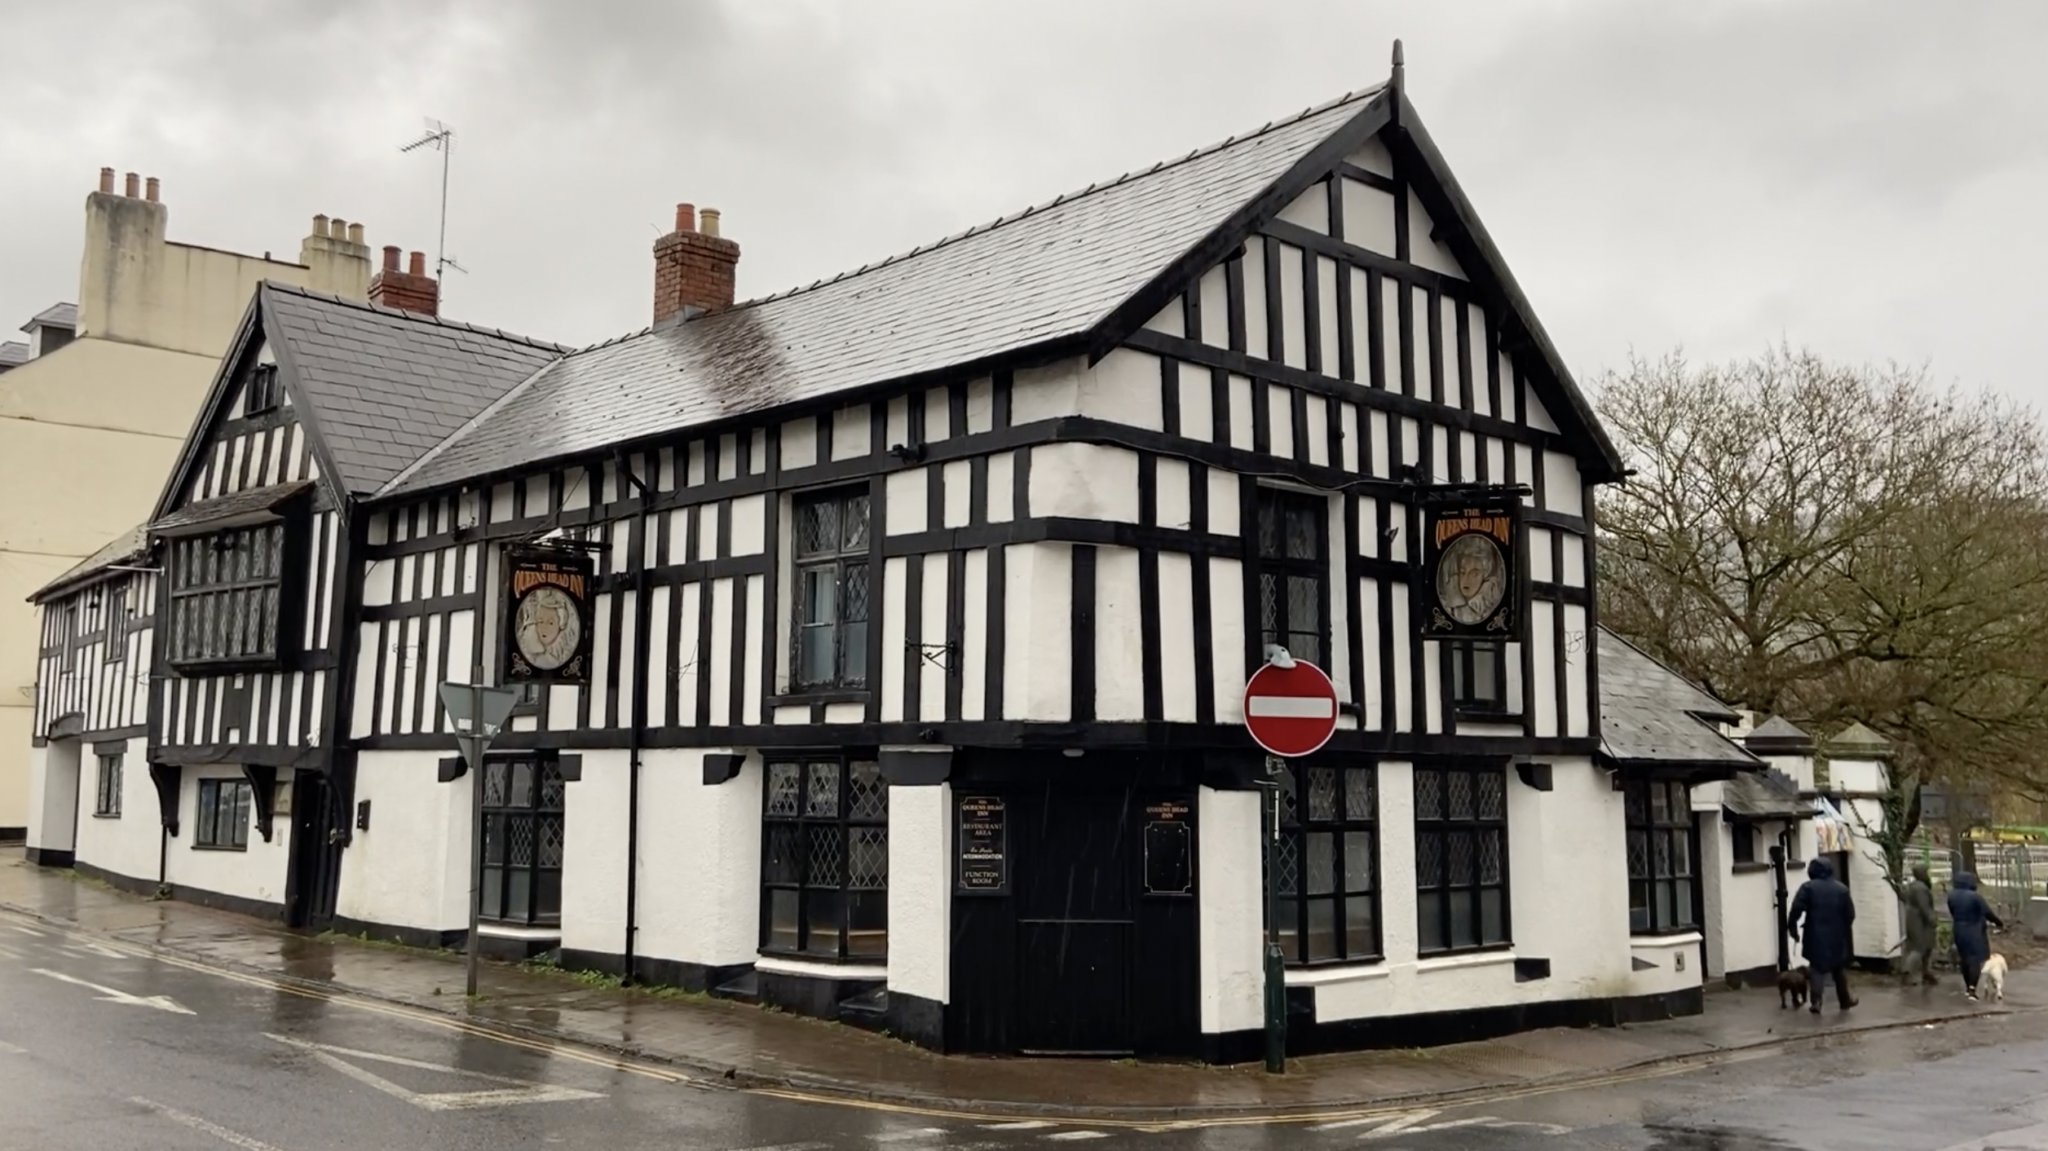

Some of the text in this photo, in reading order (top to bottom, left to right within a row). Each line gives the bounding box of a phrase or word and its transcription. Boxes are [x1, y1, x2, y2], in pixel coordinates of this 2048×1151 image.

[1463, 508, 1481, 517] THE
[1435, 516, 1511, 550] QUEENS HEAD INN
[541, 563, 558, 571] THE
[514, 570, 585, 600] QUEENS HEAD INN
